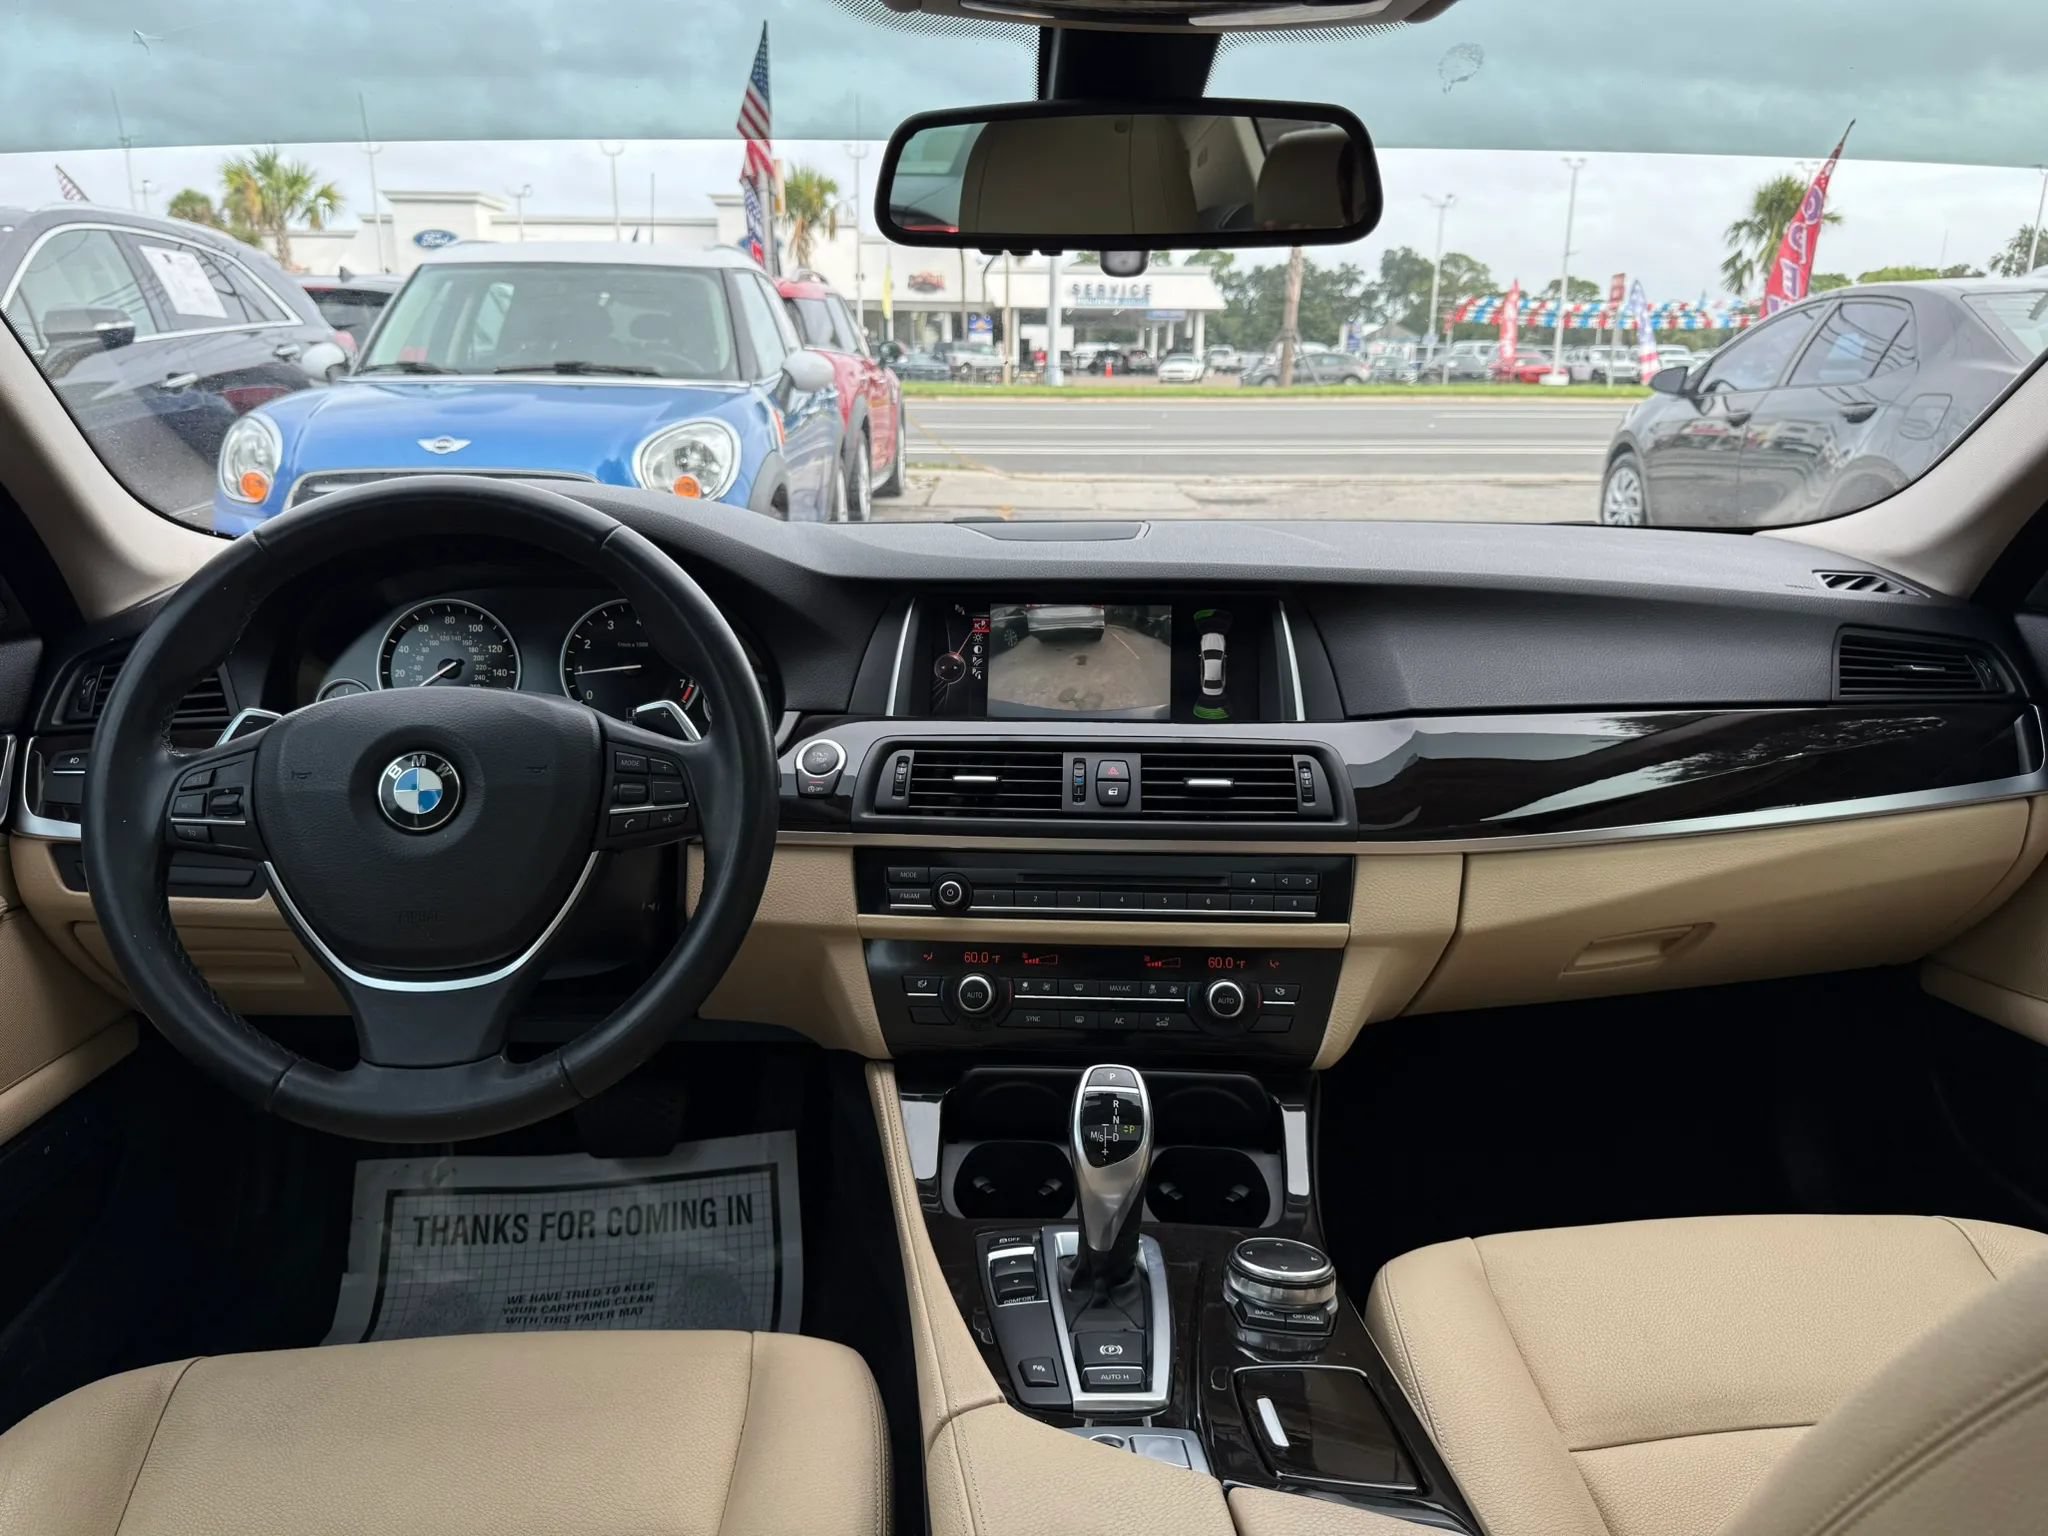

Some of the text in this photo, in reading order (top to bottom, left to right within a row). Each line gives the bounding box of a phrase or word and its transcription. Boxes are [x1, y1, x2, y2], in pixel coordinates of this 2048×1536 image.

[1071, 283, 1152, 296] SERVICE
[444, 616, 456, 625] 80
[607, 620, 615, 630] 3
[418, 624, 429, 632] 60
[468, 624, 484, 632] 100
[398, 645, 409, 653] 40
[487, 645, 503, 653] 120
[584, 640, 592, 649] 2
[394, 669, 406, 678] 20
[492, 668, 508, 677] 140
[679, 679, 686, 689] 7
[586, 689, 593, 700] 0
[387, 754, 453, 780] BMW
[621, 759, 641, 767] MODE
[900, 871, 917, 879] MODE
[964, 951, 989, 964] 60.0
[1207, 956, 1234, 969] 60.0
[966, 991, 983, 999] AUTO
[1217, 996, 1235, 1004] AUTO
[1112, 1116, 1120, 1124] N
[1112, 1132, 1120, 1142] D
[413, 1193, 753, 1247] THANKS FOR COMING IN
[507, 1281, 655, 1305] WE HAVE TRIED TO KEEP
[502, 1294, 654, 1316] YOUR CARPETING CLEAN
[505, 1305, 645, 1325] WITH THIS PAPER MAT
